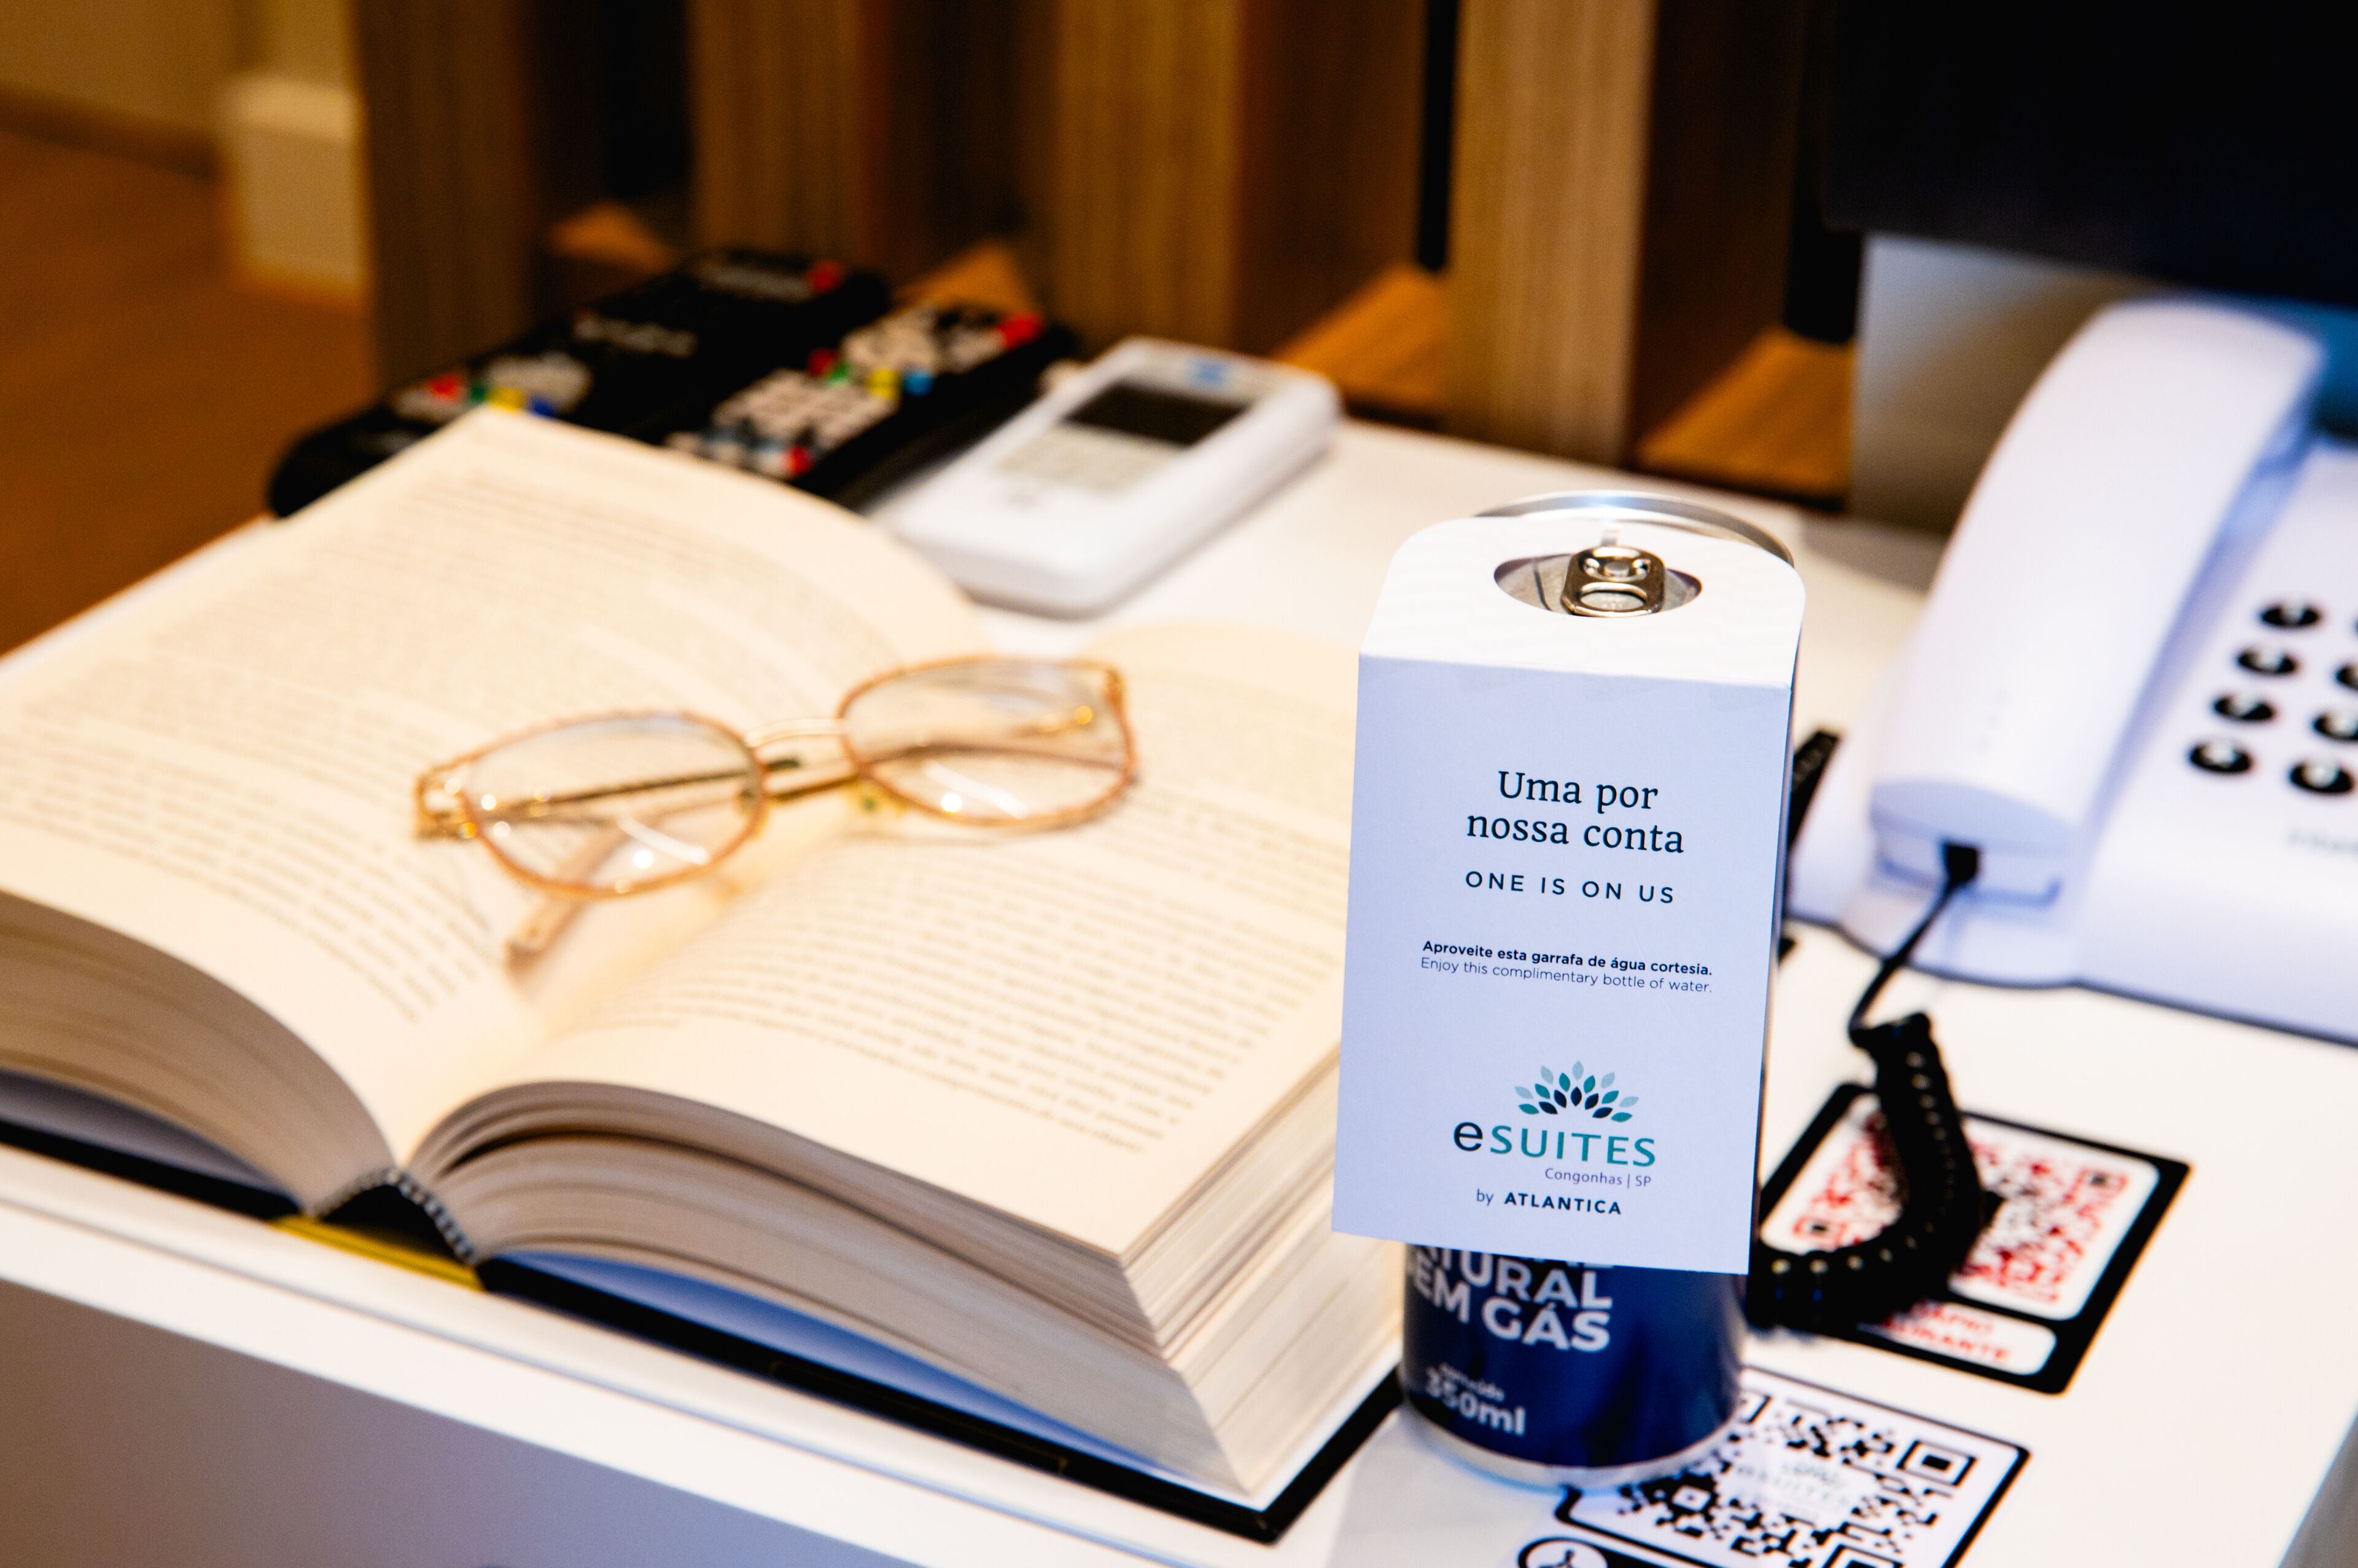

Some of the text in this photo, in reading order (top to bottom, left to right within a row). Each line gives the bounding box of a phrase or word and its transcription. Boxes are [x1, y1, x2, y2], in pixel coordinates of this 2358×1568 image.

[1498, 770, 1659, 815] Uma por
[1466, 815, 1684, 854] nossa conta
[1465, 871, 1674, 904] ONE IS ON US
[1421, 957, 1713, 993] Enjoy this complimentary bottle of water.
[1422, 940, 1713, 976] Aproveite esta garrafa de água cortesia.
[1452, 1121, 1656, 1168] eSUITES
[1545, 1168, 1622, 1185] Congonhas
[1635, 1175, 1651, 1187] SP
[1476, 1188, 1622, 1216] by ATLANTICA
[1481, 1296, 1612, 1351] GÁS
